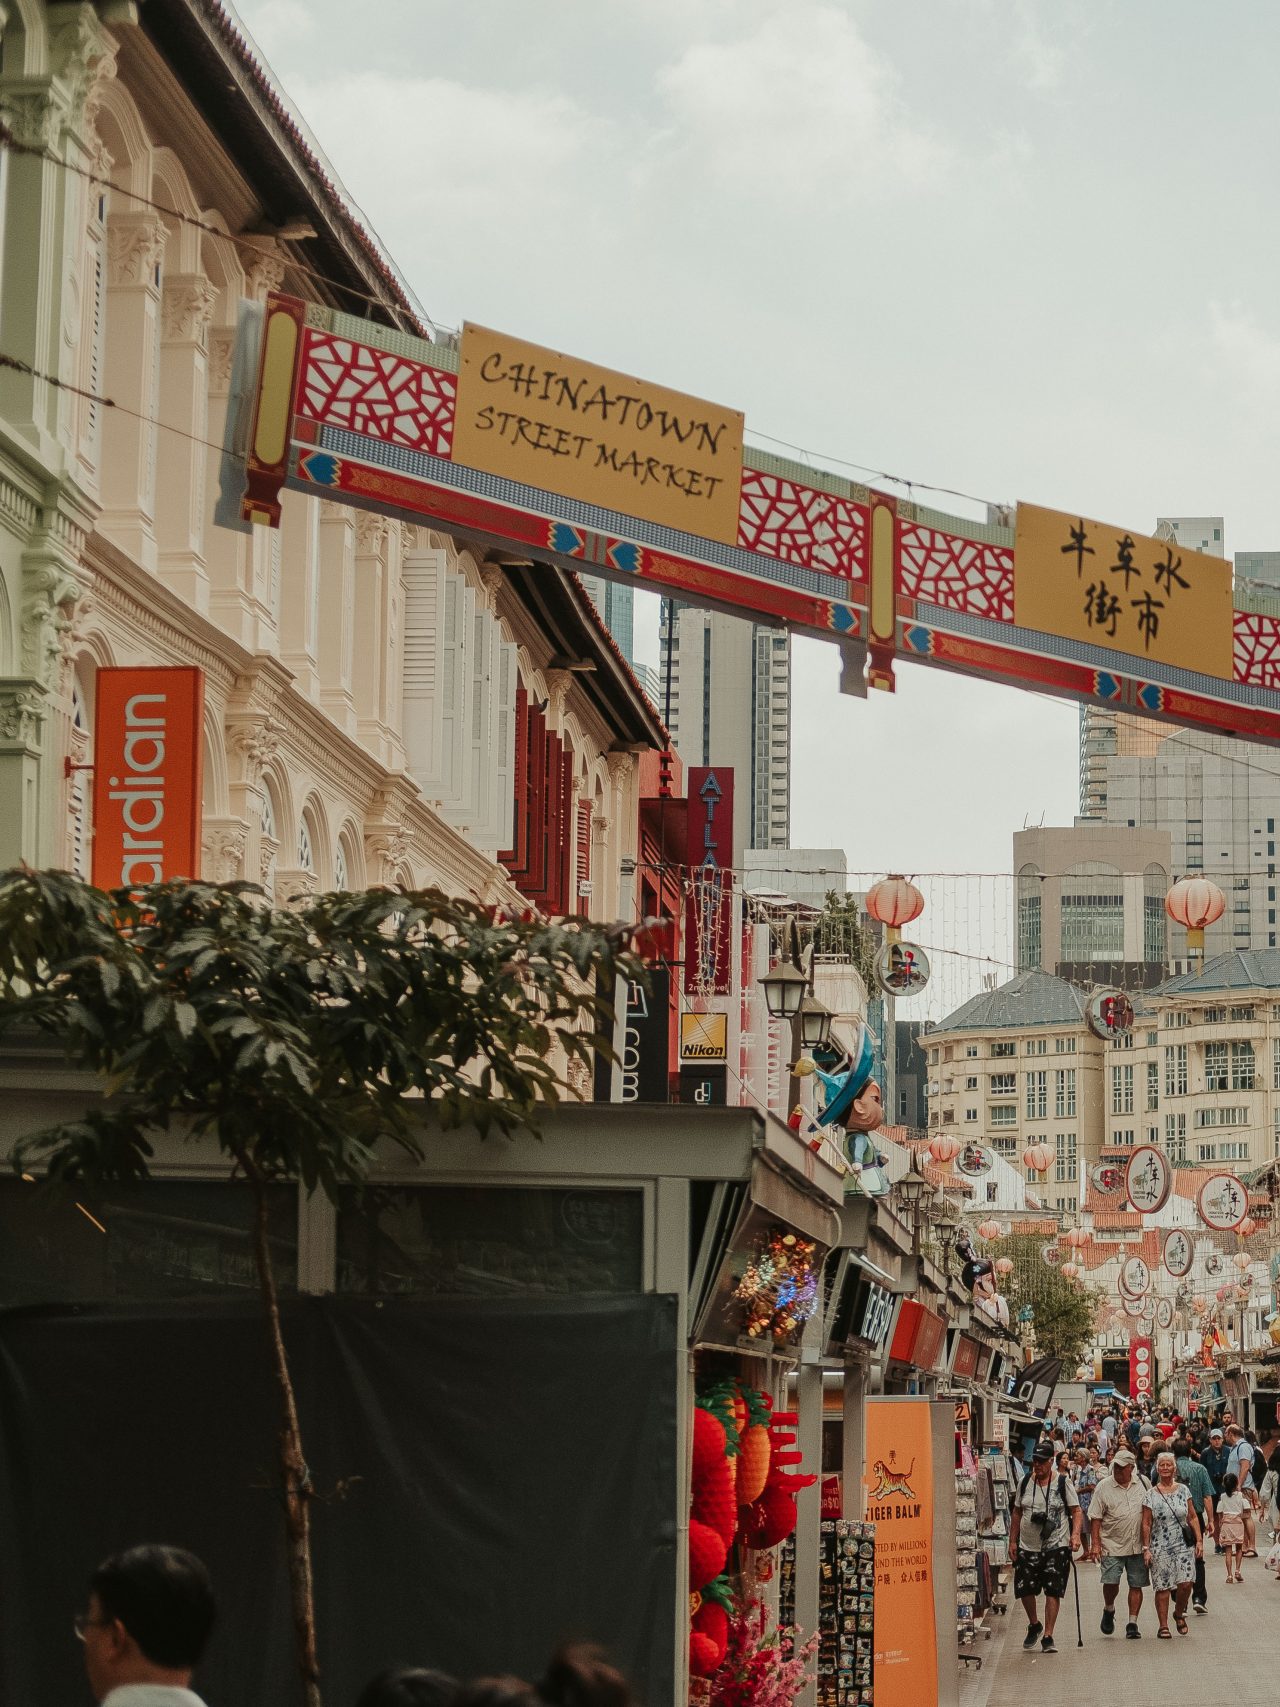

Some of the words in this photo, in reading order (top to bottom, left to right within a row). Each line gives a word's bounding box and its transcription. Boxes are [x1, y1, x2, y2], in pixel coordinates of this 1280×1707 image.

[480, 352, 727, 456] CHINATOWN
[475, 405, 593, 459] STREET
[593, 443, 724, 500] MARKET
[1083, 580, 1165, 652] 街市
[109, 694, 167, 895] ardian
[683, 1044, 723, 1056] Nikon
[865, 1506, 893, 1522] TIGER
[895, 1503, 921, 1519] BALM
[875, 1558, 890, 1569] UND
[891, 1557, 905, 1568] THE
[904, 1554, 928, 1566] WORLD
[890, 1542, 898, 1552] BY
[899, 1540, 927, 1551] MILLIONS
